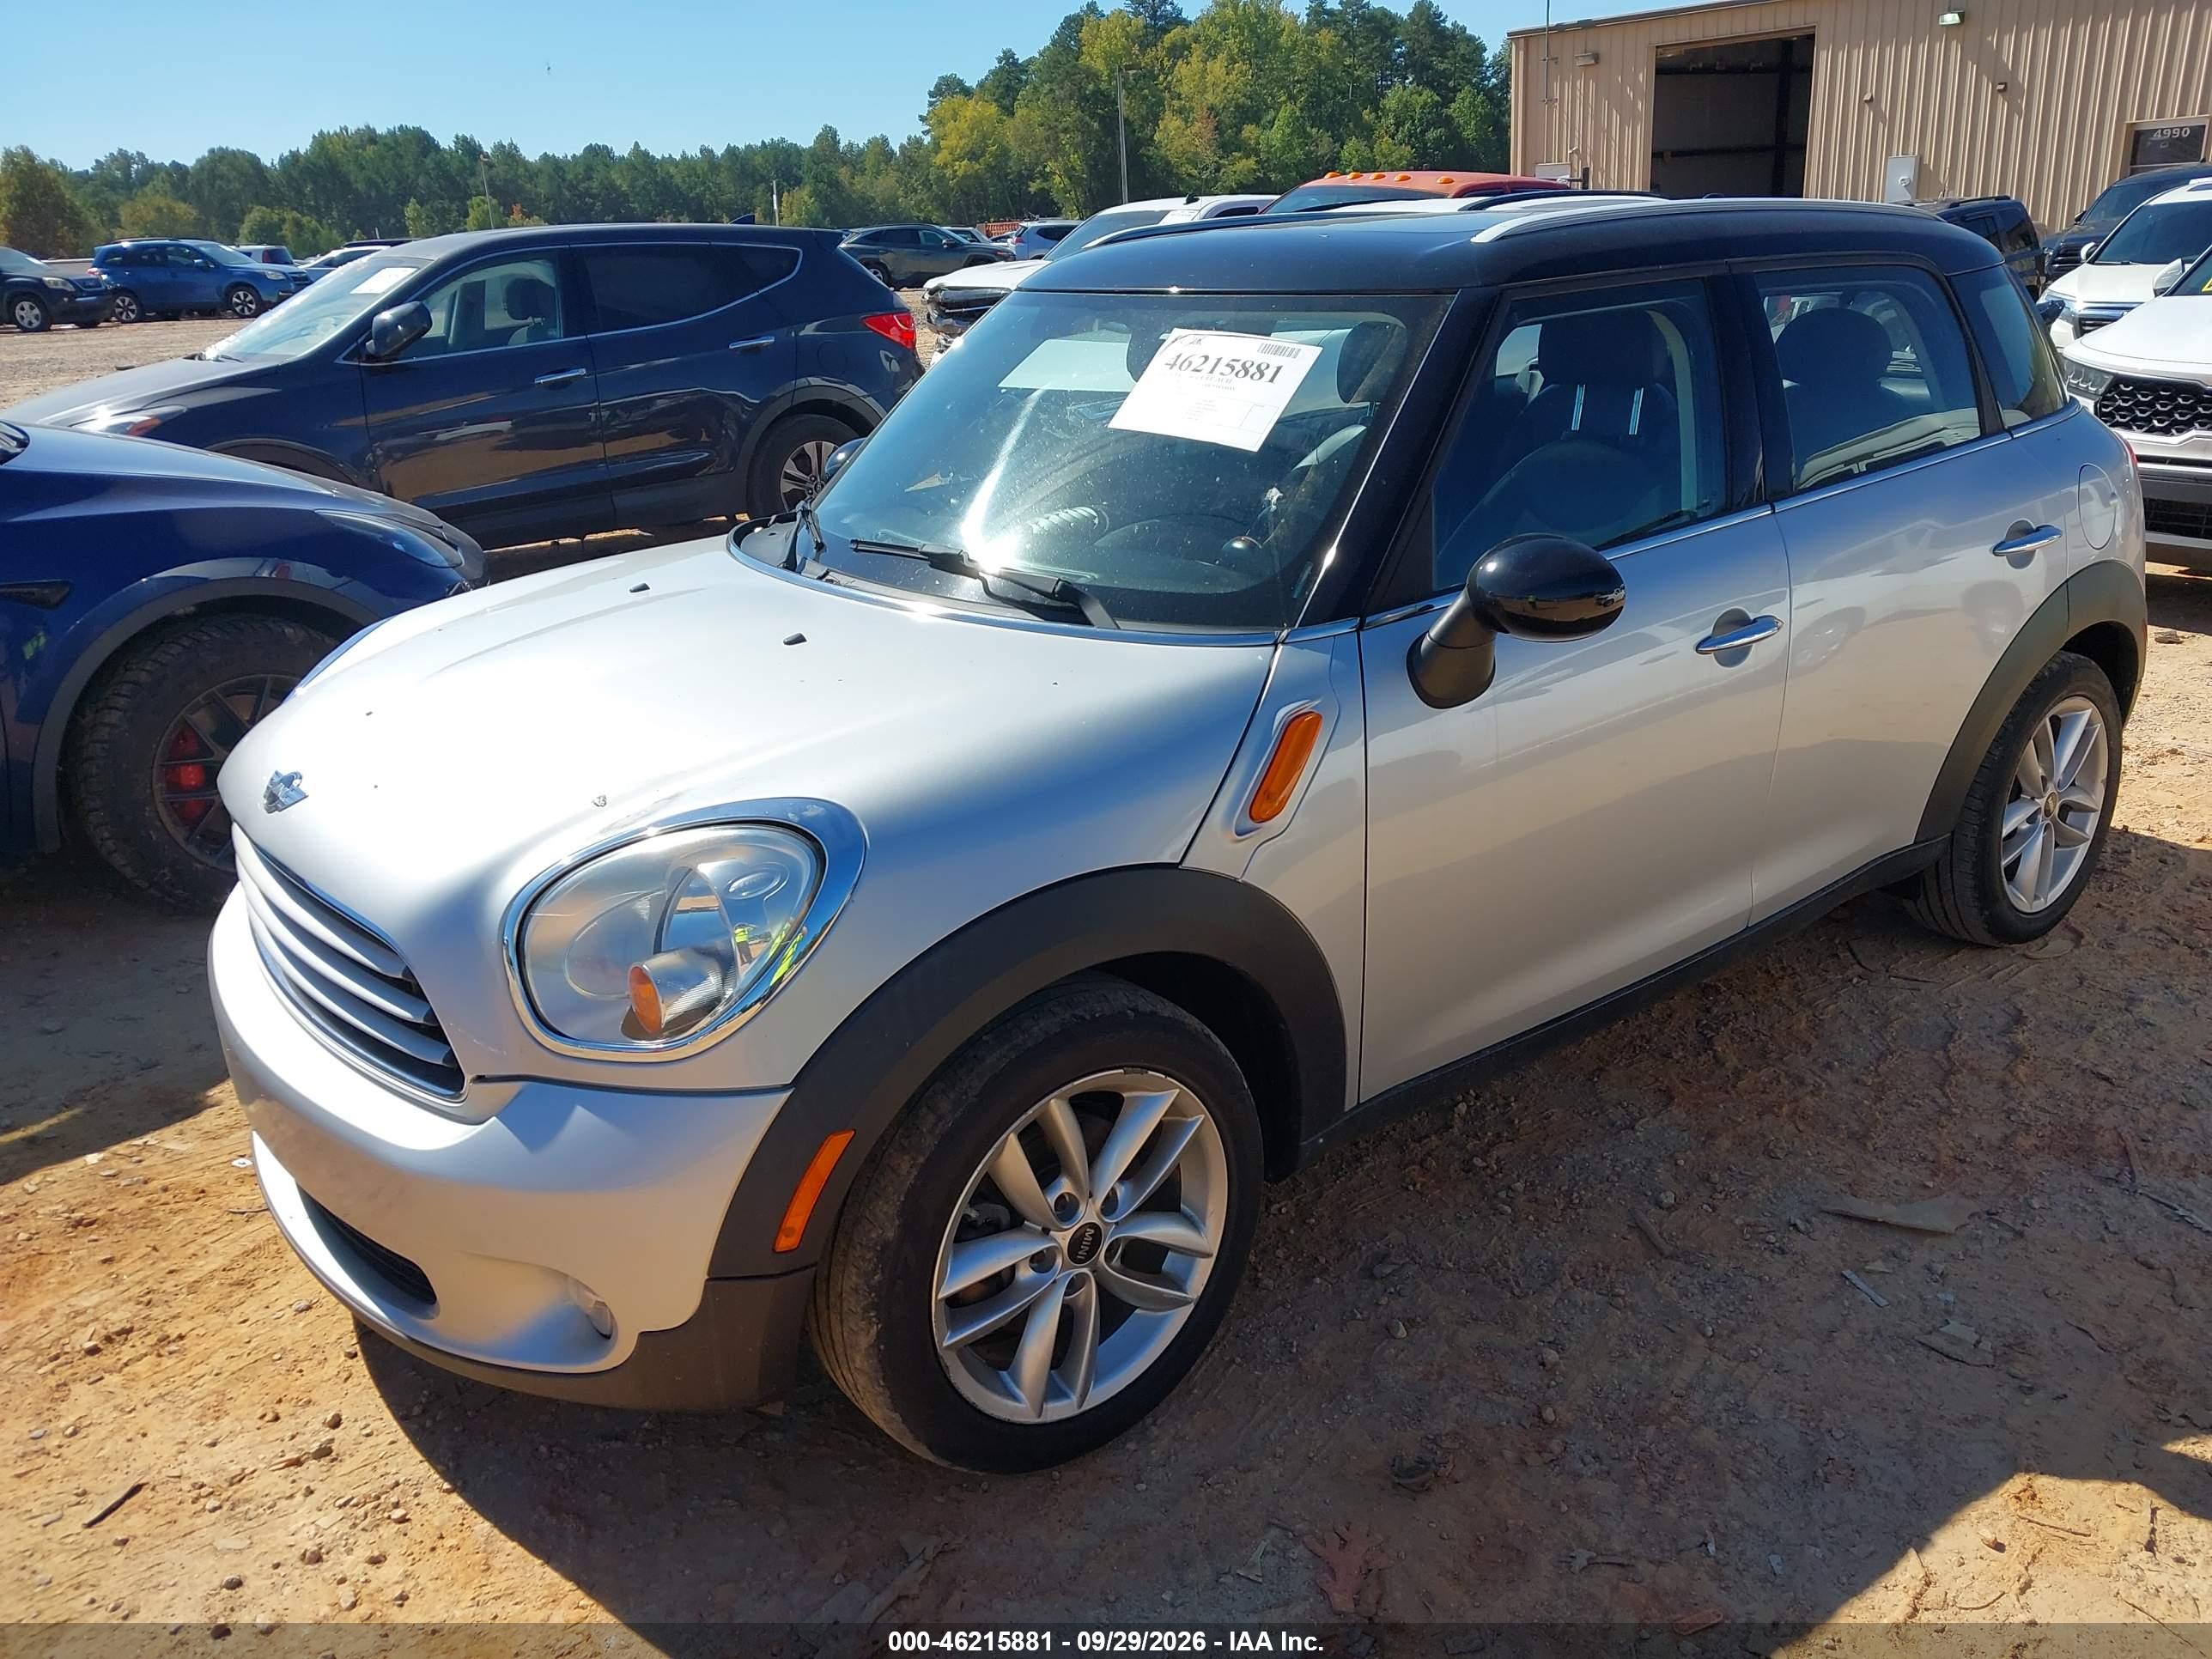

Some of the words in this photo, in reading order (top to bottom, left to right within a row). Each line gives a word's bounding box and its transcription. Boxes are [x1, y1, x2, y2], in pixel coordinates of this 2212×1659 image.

[2153, 127, 2191, 138] 4990
[1164, 352, 1284, 385] 46215881
[1076, 1228, 1095, 1260] MINI
